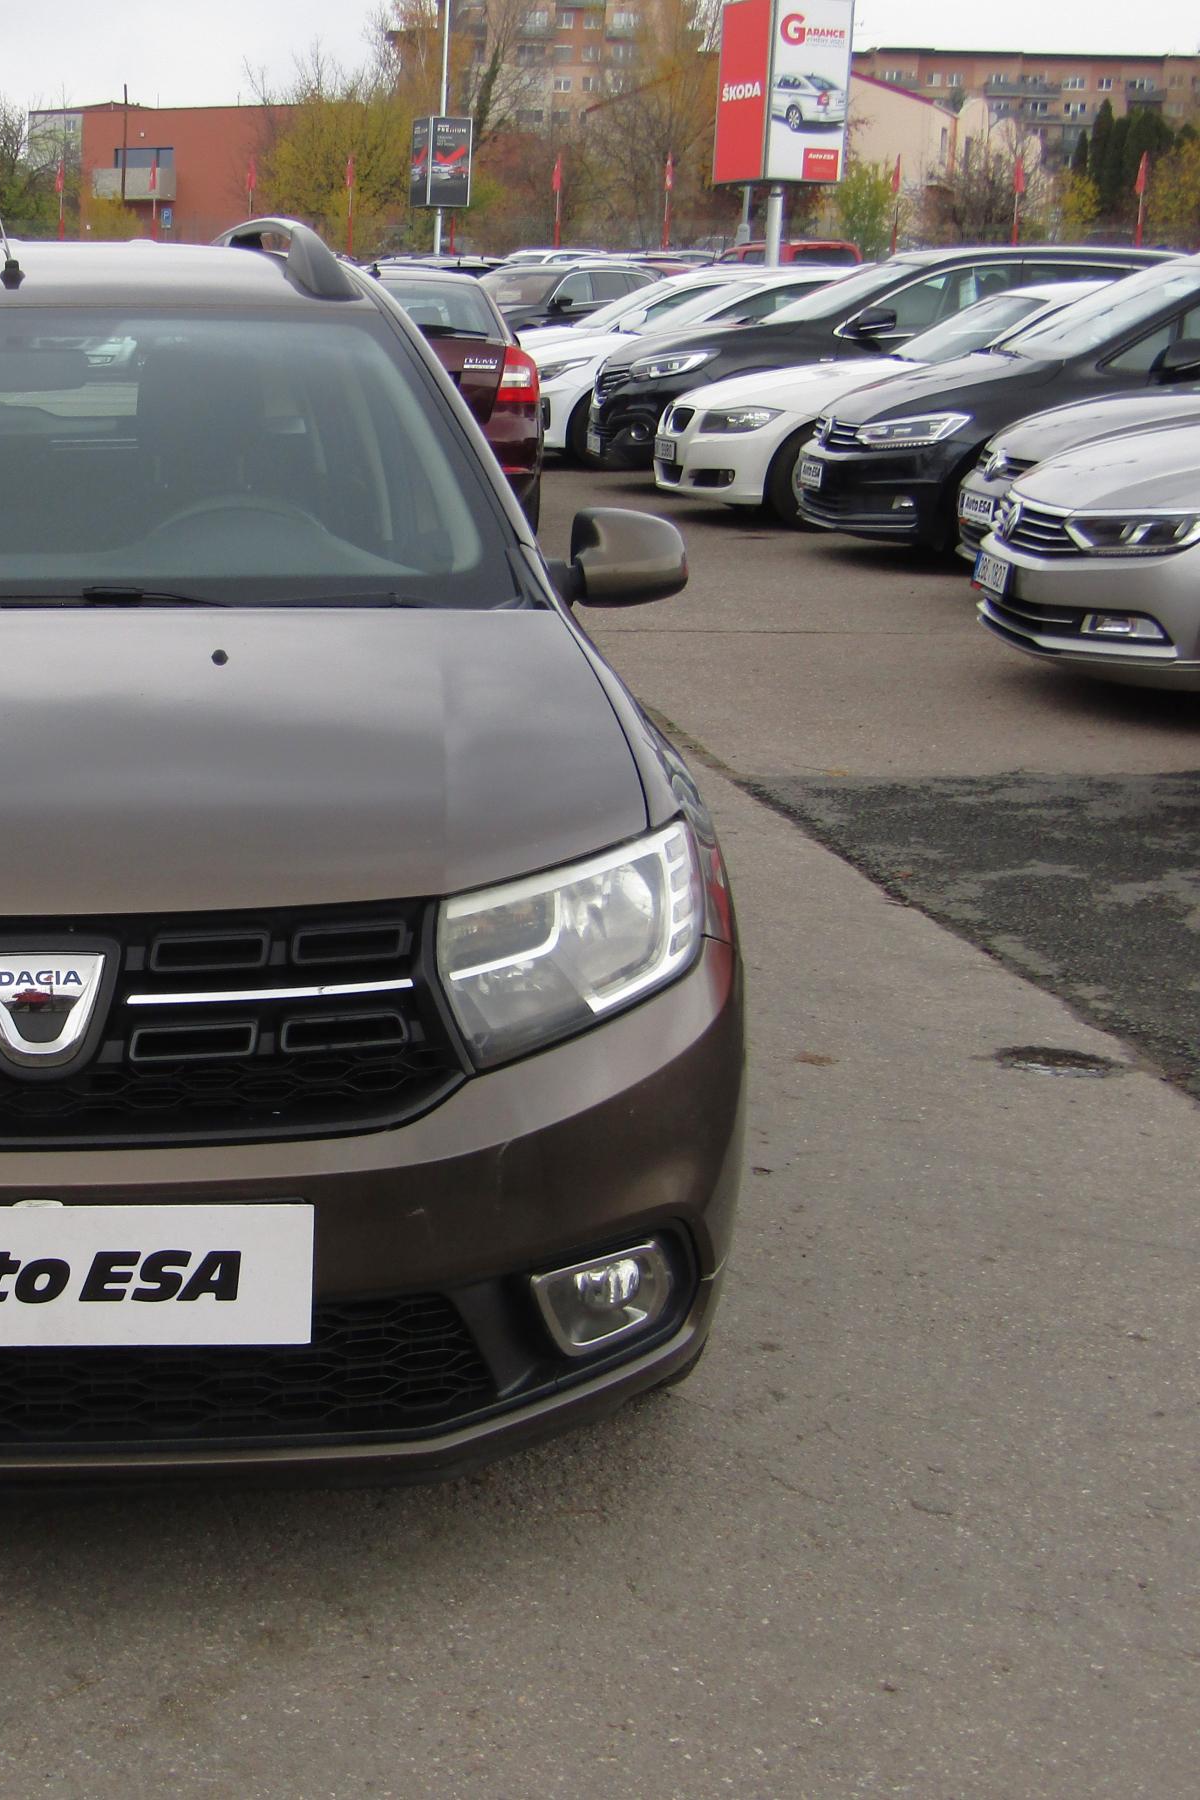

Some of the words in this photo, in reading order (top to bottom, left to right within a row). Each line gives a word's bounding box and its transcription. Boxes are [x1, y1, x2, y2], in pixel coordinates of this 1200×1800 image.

[780, 13, 845, 46] GARANCE
[722, 82, 761, 102] ŠKODA
[163, 212, 169, 221] P
[978, 499, 991, 514] ESA
[78, 1249, 241, 1302] ESA
